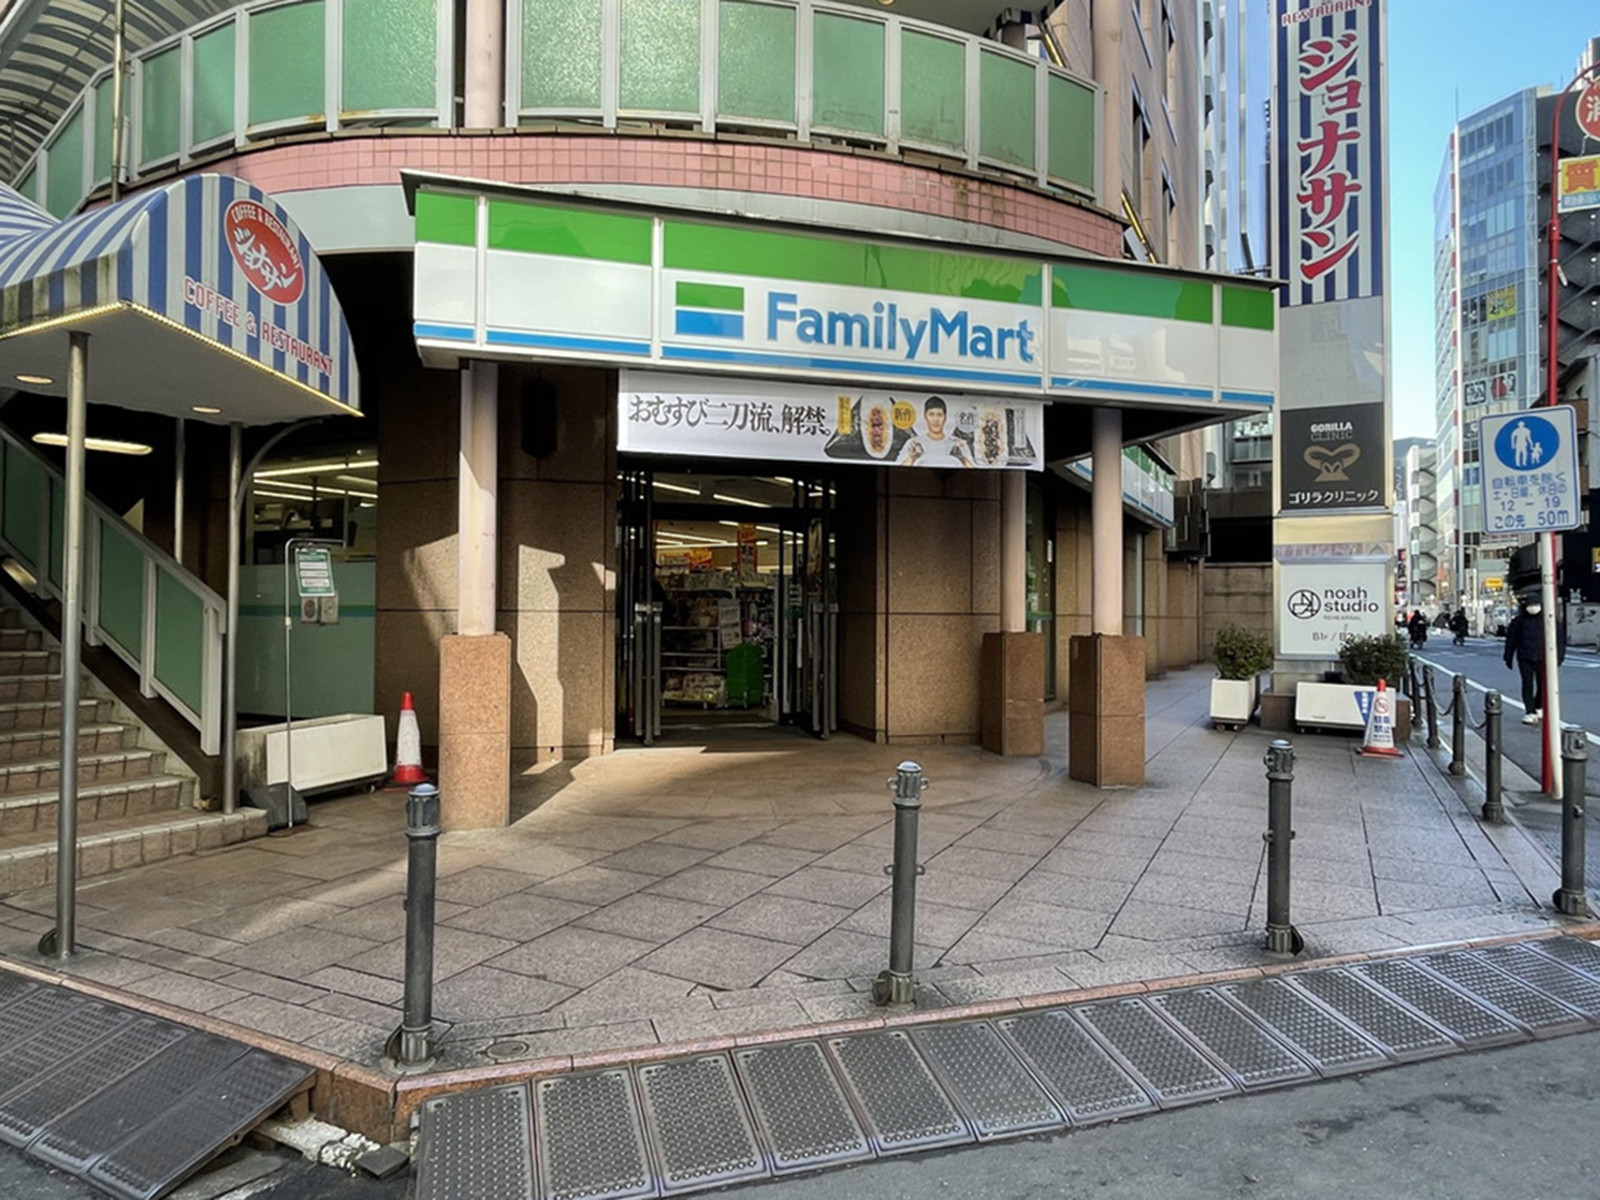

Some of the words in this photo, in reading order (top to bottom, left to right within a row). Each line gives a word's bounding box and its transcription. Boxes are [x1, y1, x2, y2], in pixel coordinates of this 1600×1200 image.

[1297, 31, 1363, 282] ジョナサン
[231, 204, 257, 223] COFFEE
[264, 213, 301, 269] RESTAURANT
[184, 275, 240, 328] COFFEE
[245, 311, 257, 338] &
[261, 321, 334, 377] RESTAURANT
[767, 291, 1036, 363] FamilyMart
[629, 394, 832, 437] おむすび二刀流、解禁。
[1310, 421, 1353, 433] GORILLA
[1310, 430, 1353, 441] CLINIC
[1492, 471, 1567, 489] 自転車を除く
[1288, 489, 1379, 505] ゴリラクリニック
[1500, 500, 1515, 511] 12
[1544, 496, 1561, 508] 19
[1494, 514, 1526, 529] この先
[1538, 510, 1569, 526] 50m
[1324, 586, 1368, 600] noah
[1324, 599, 1379, 612] studio
